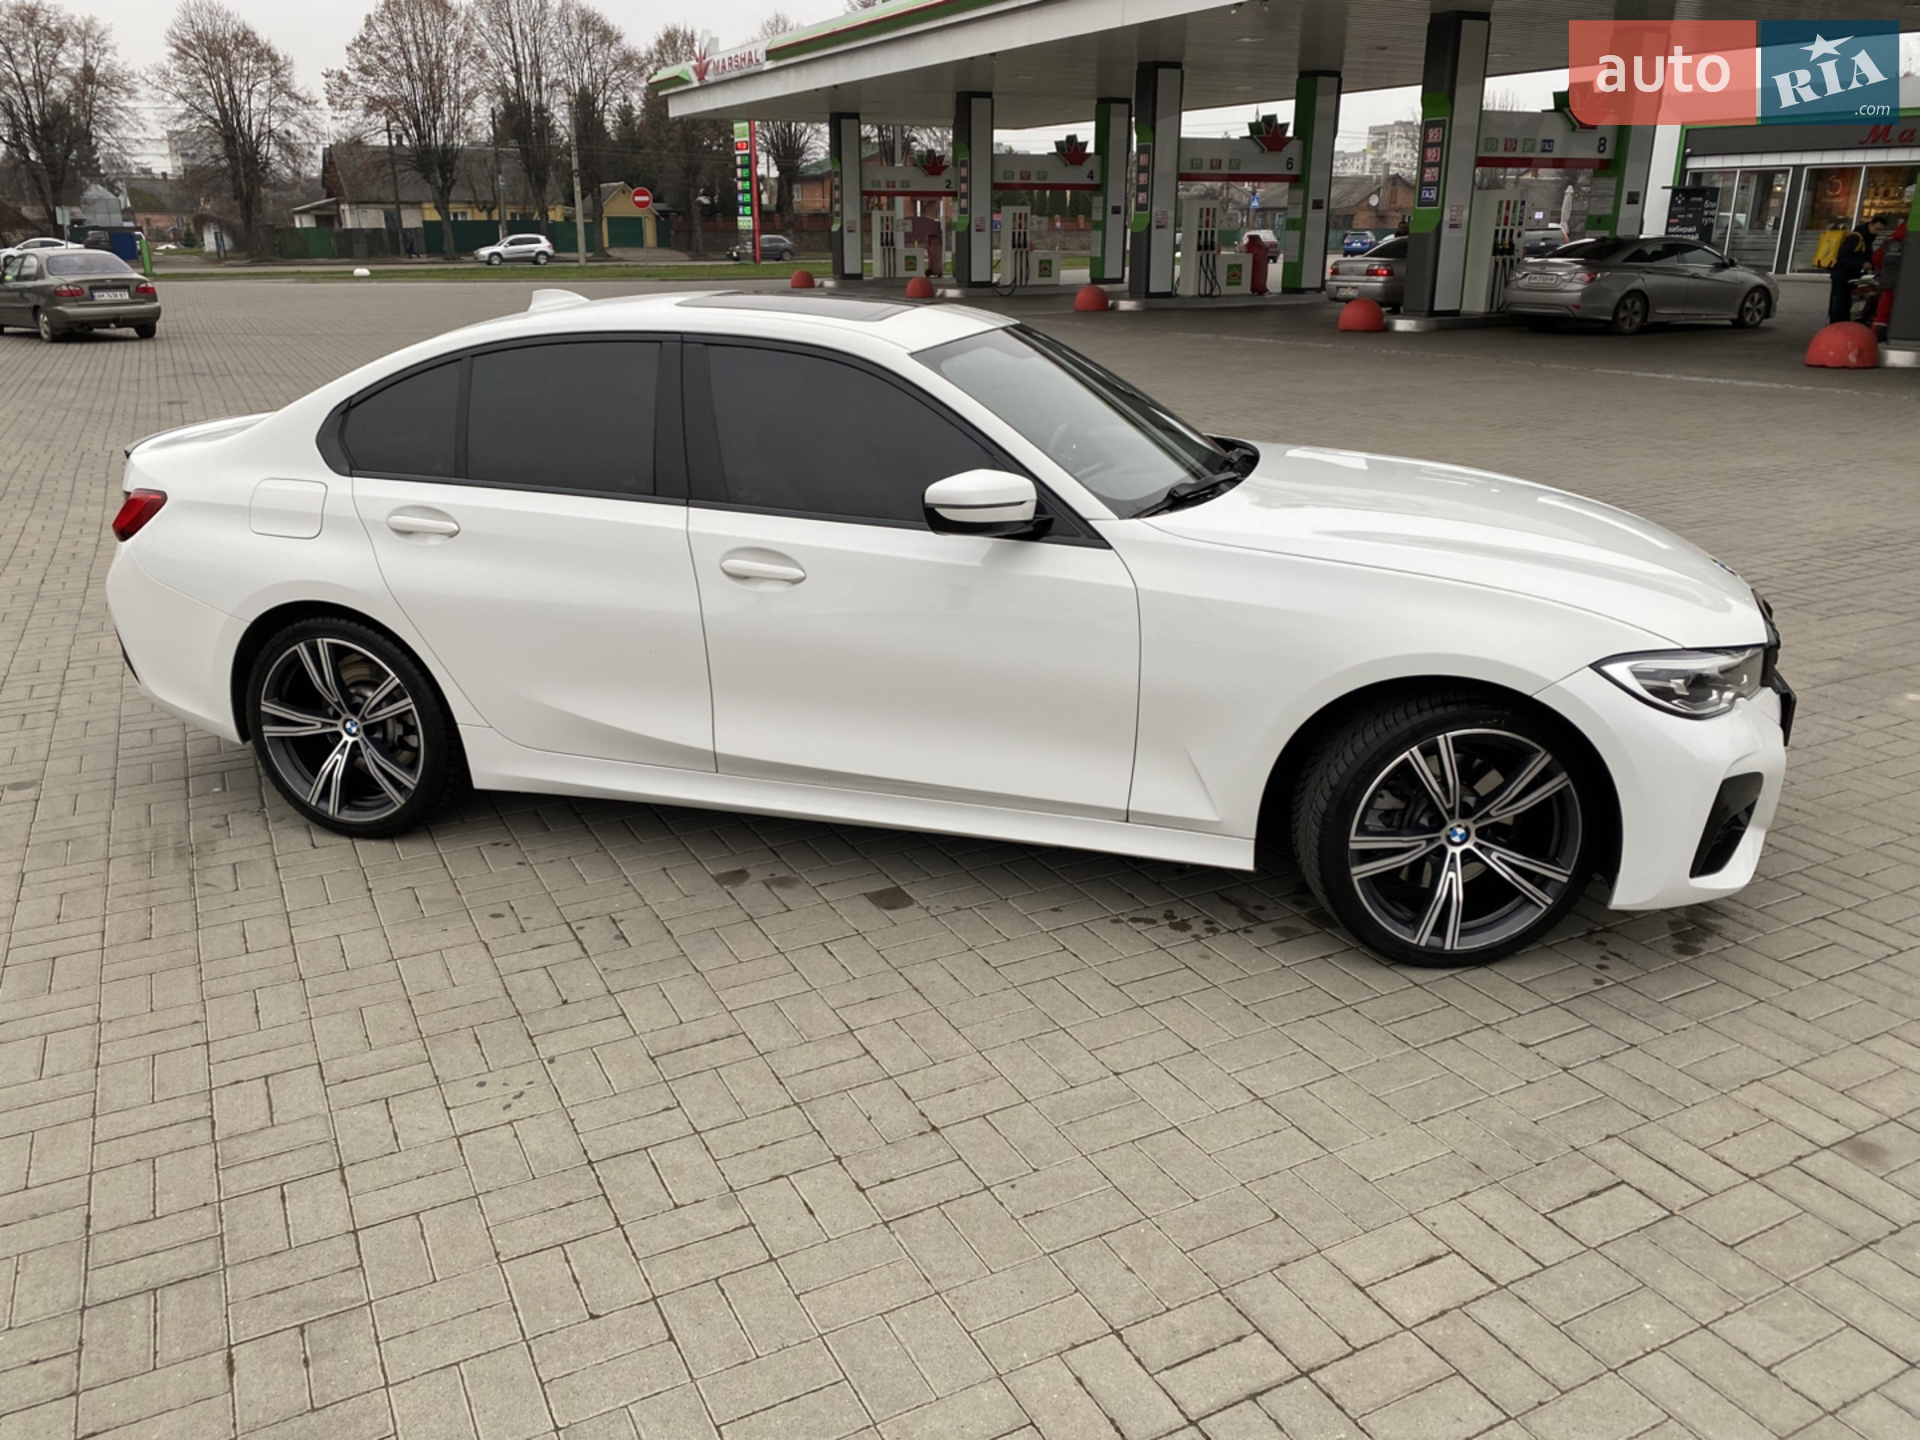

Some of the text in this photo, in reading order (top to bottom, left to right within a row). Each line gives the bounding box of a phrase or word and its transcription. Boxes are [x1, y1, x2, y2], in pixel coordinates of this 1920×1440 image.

[712, 49, 761, 74] MARSHAL
[1597, 136, 1607, 154] 8
[1286, 157, 1294, 170] 6
[1086, 169, 1094, 181] 4
[945, 179, 952, 189] 2
